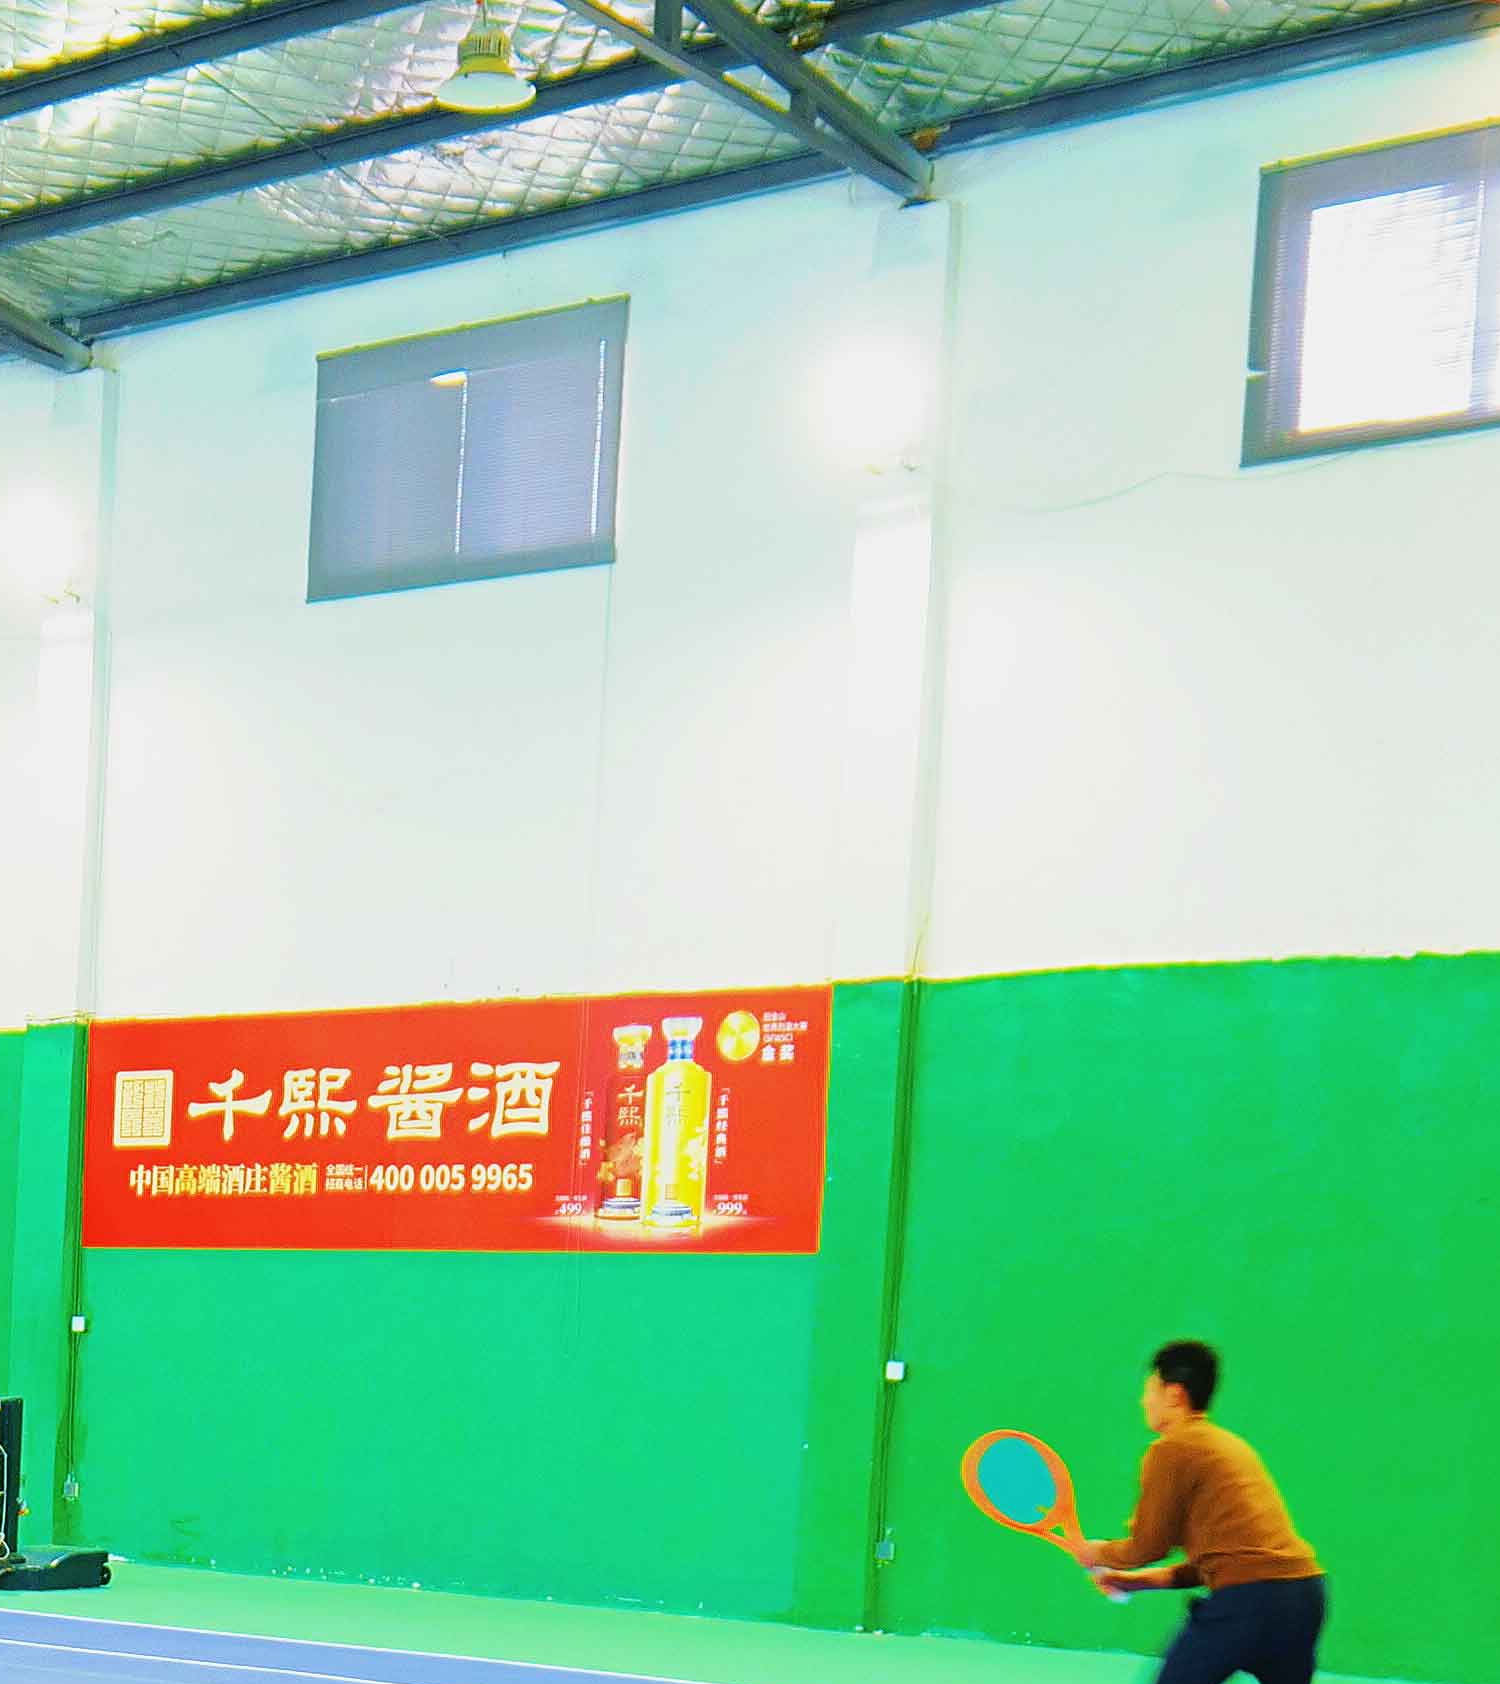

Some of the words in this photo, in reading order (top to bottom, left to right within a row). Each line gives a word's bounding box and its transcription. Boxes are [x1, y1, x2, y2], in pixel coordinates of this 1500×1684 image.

[188, 1061, 561, 1143] 千熙酱酒
[617, 1083, 645, 1126] 千熙
[128, 1162, 319, 1196] 中国高端酒庄酱酒
[370, 1163, 411, 1192] 400
[419, 1163, 465, 1192] 005
[471, 1163, 534, 1191] 9965
